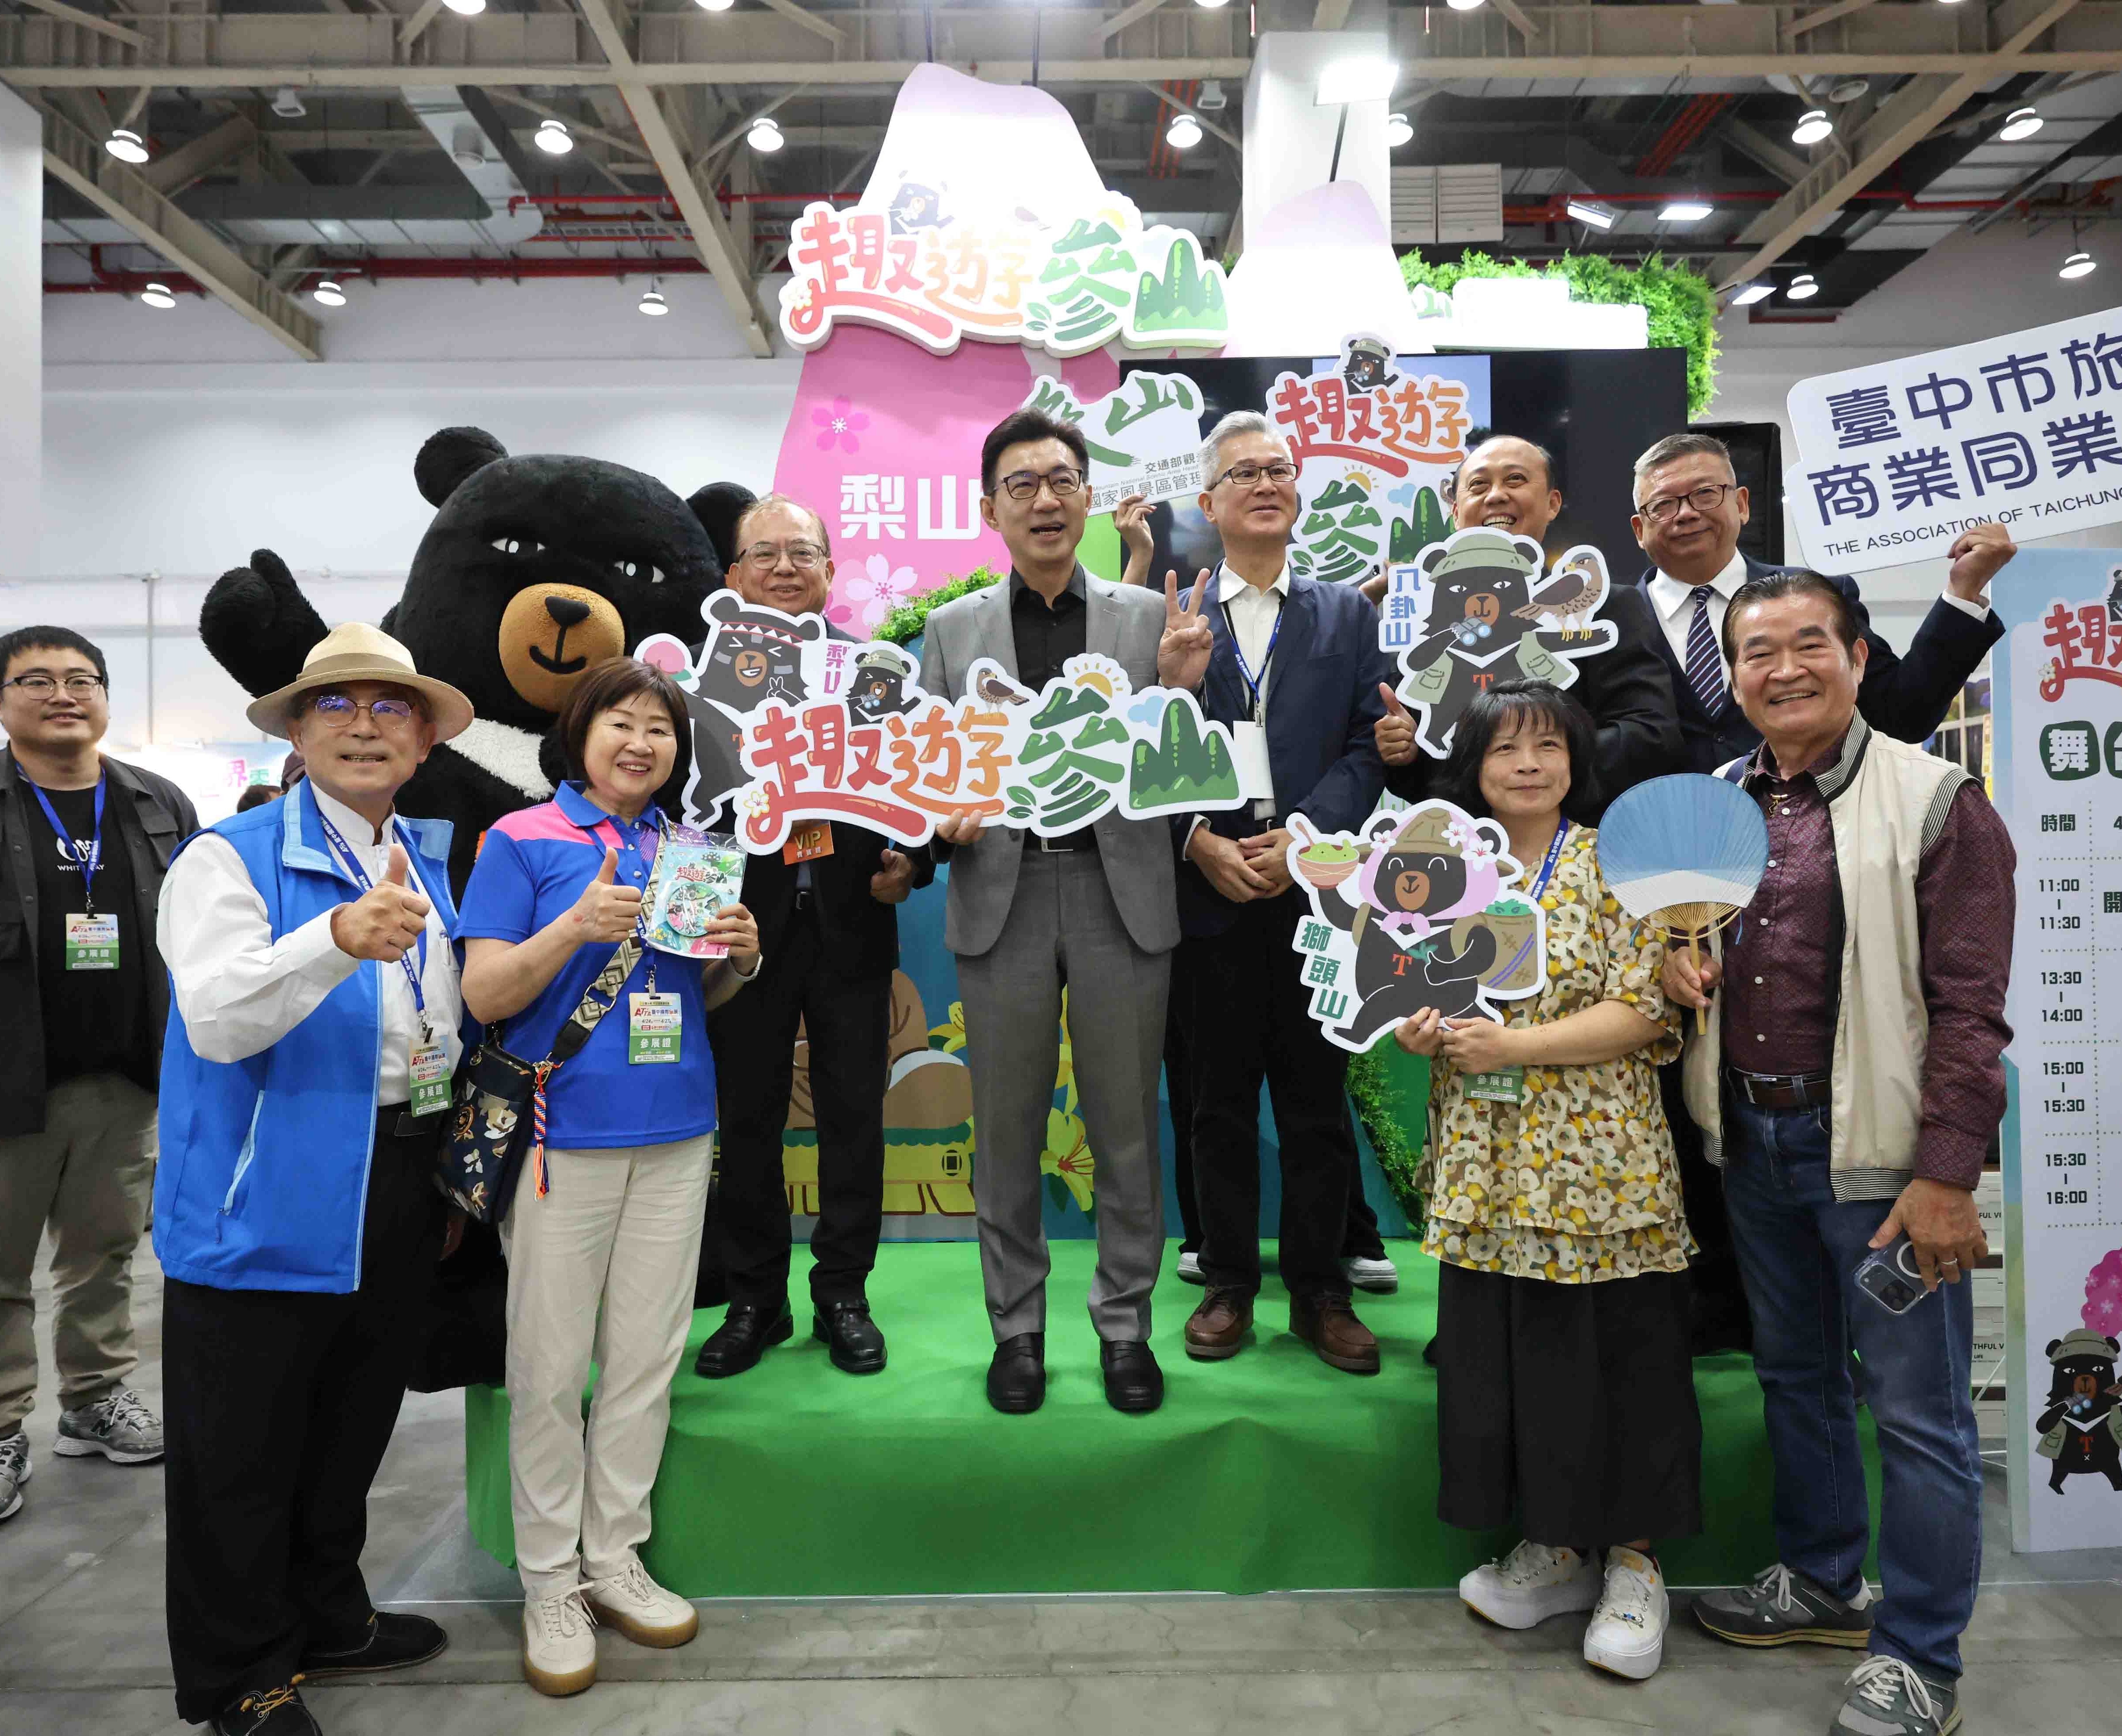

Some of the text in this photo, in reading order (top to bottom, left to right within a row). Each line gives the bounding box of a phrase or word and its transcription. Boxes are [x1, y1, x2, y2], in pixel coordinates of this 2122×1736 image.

[1145, 453, 1199, 473] 交通部觀
[1807, 410, 2122, 526] 商業同業
[841, 474, 981, 540] 梨山
[1824, 540, 1861, 557] THE
[1999, 508, 2023, 524] OF
[2029, 487, 2122, 517] TAICHUN
[1385, 568, 1421, 646] 八卦山
[2042, 814, 2075, 831] 時間
[795, 830, 821, 850] VIP
[2039, 879, 2079, 891] 11:00
[2040, 917, 2080, 929] 11:30
[1301, 921, 1348, 1019] 獅頭山
[1392, 953, 1413, 976] T
[2042, 972, 2081, 984] 13:30
[2042, 1009, 2082, 1021] 14:00
[640, 1037, 671, 1049] 參展證
[2043, 1062, 2083, 1075] 15:00
[1477, 1075, 1512, 1087] 參展證
[419, 1084, 443, 1100] 參展證
[2044, 1100, 2084, 1112] 15:30
[2046, 1153, 2086, 1166] 15:30
[2047, 1191, 2087, 1204] 16:00
